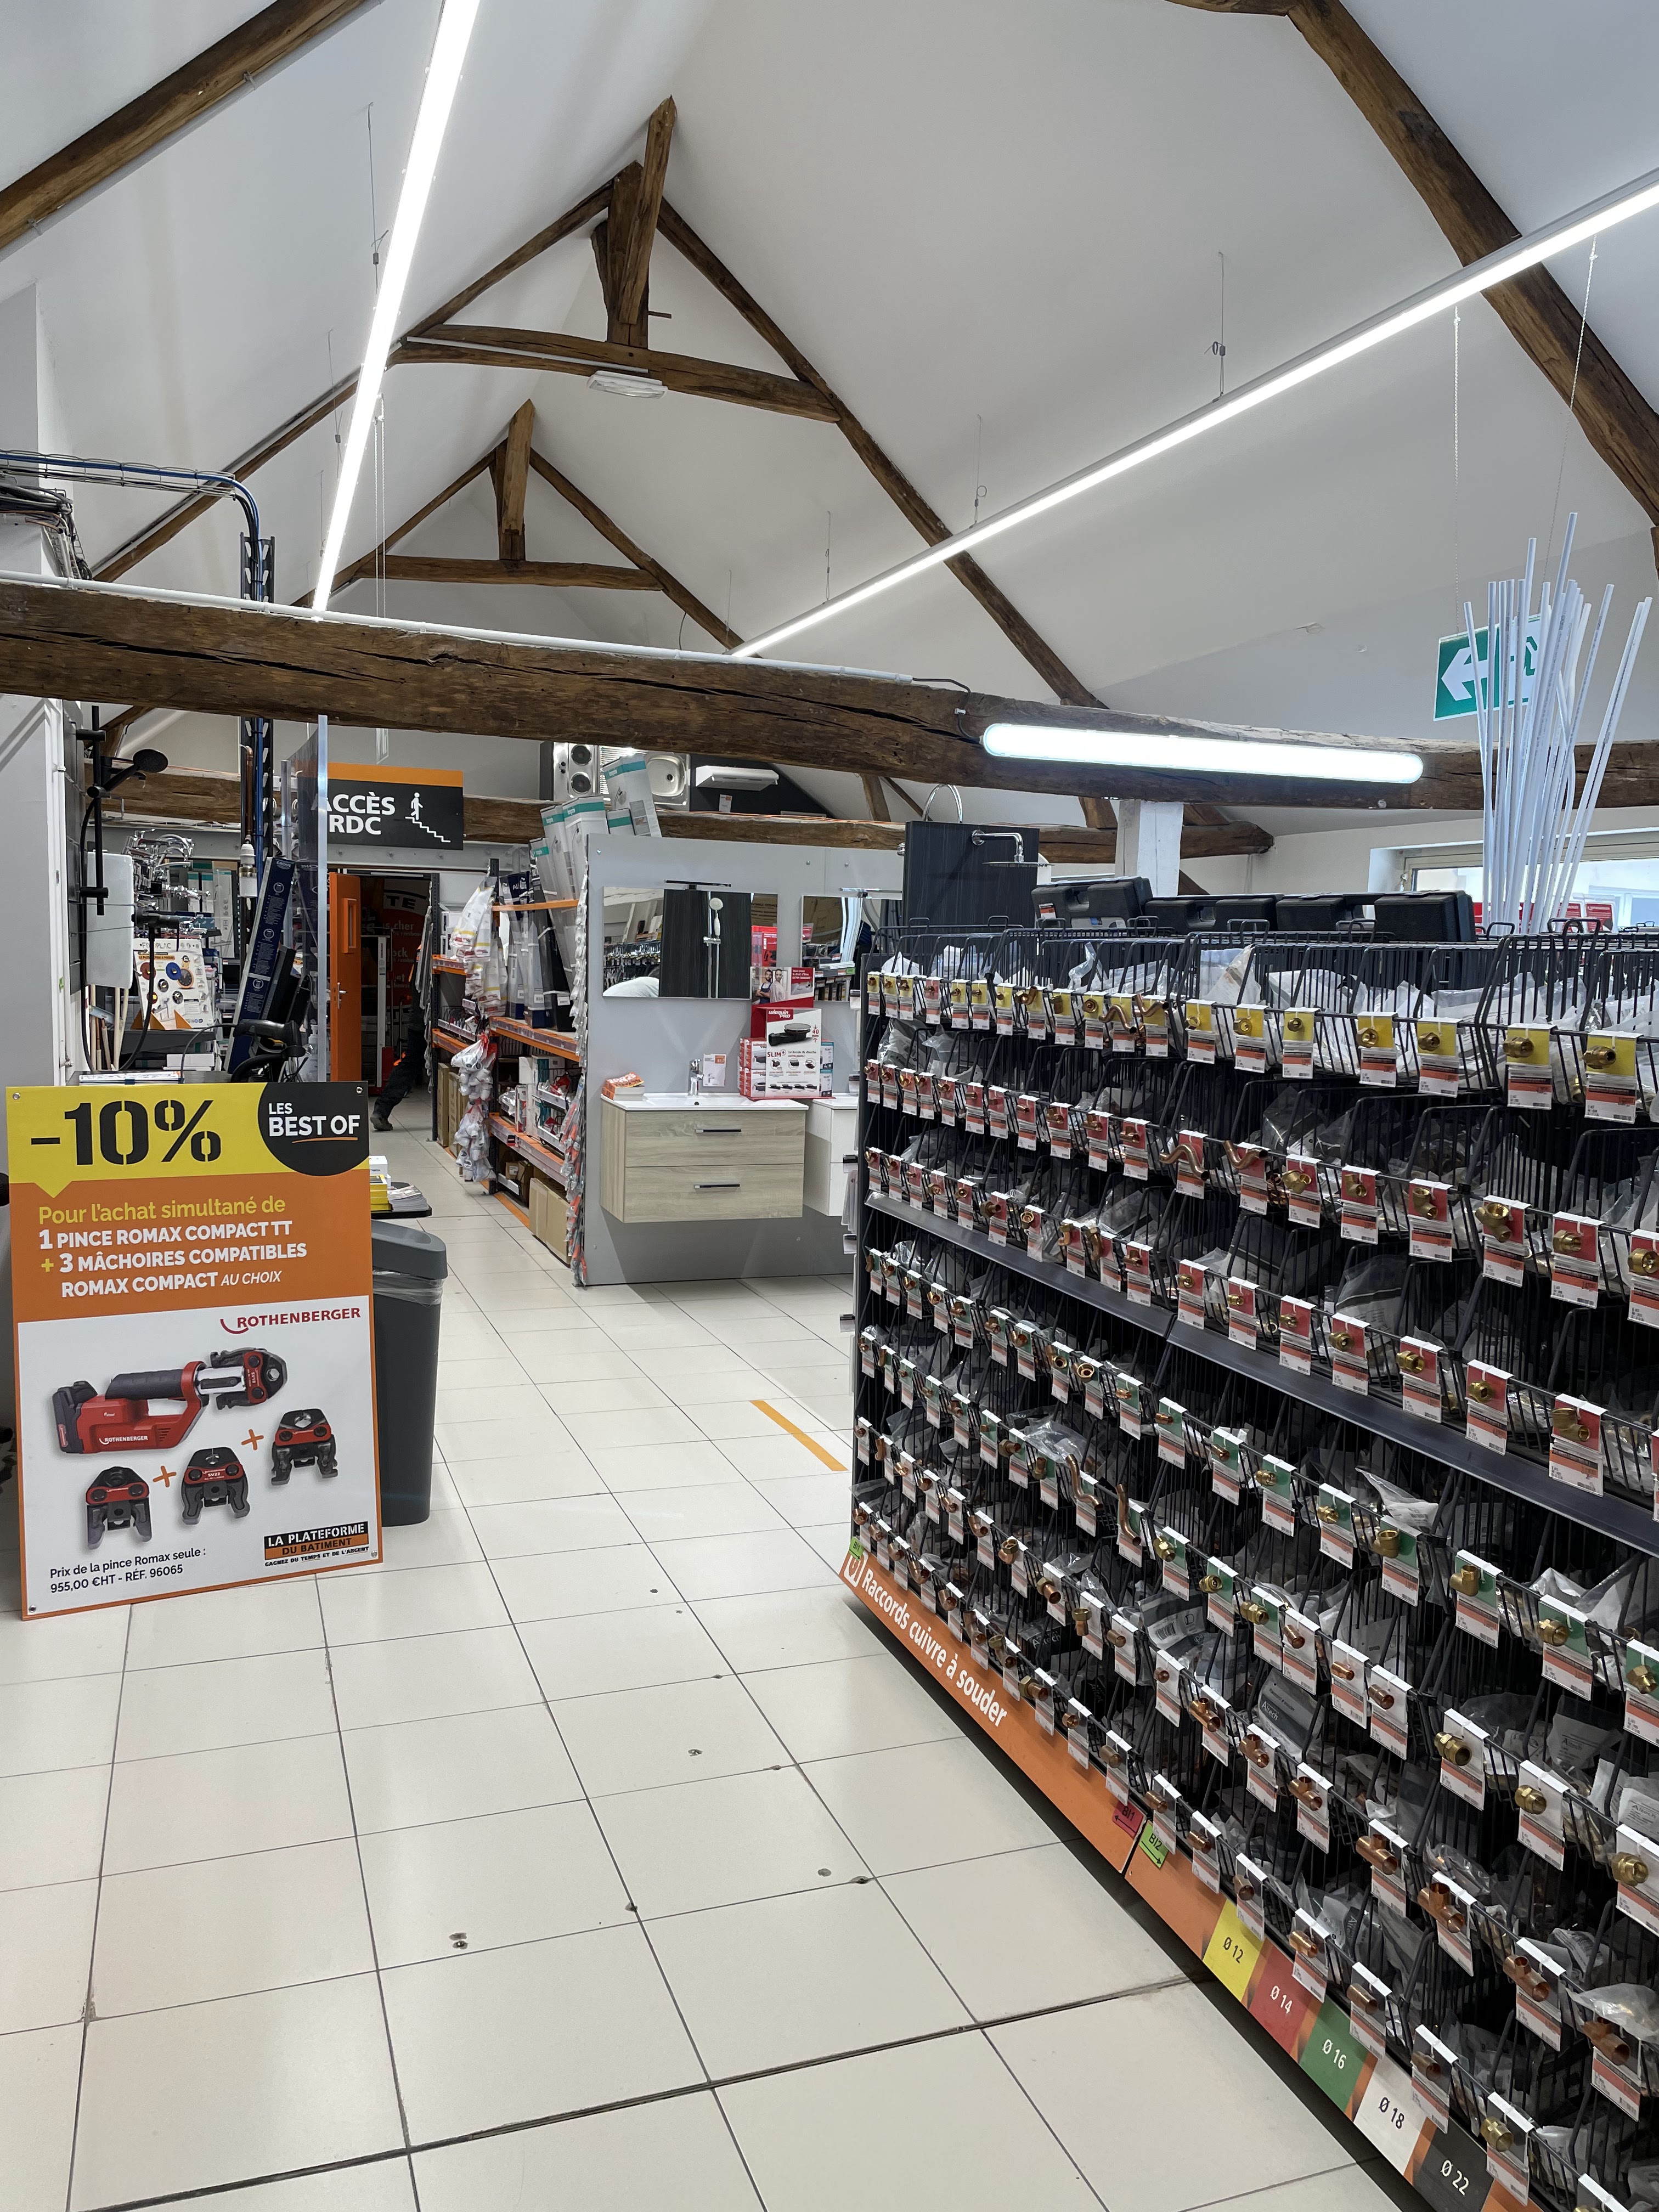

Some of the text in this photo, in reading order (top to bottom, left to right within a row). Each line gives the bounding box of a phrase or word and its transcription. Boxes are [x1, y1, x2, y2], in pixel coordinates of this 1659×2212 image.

[329, 814, 381, 835] RDC
[269, 1103, 292, 1115] LES
[269, 1115, 360, 1137] BEST OF
[39, 1205, 87, 1225] Pour
[162, 1196, 257, 1218] simultané
[262, 1195, 285, 1213] de
[40, 1220, 292, 1250] 1 PINCE ROMAX COMPACT TT
[59, 1253, 74, 1273] 3
[78, 1250, 185, 1272] MÂCHOIRES
[189, 1243, 307, 1265] COMPATIBLES
[61, 1271, 282, 1299] ROMAX COMPACT AU CHOIX
[237, 1307, 361, 1329] ROTHENBERGER
[268, 1523, 365, 1547] LA PLATEFORME
[282, 1538, 352, 1556] DU BATIMENT
[301, 1553, 321, 1562] TEMPS
[50, 1568, 71, 1579] Prix
[73, 1565, 87, 1576] de
[90, 1562, 100, 1573] la
[103, 1559, 132, 1572] pince
[134, 1554, 171, 1566] Romax
[173, 1548, 201, 1560] seule
[50, 1578, 89, 1593] 955,00
[92, 1574, 116, 1587] €HT
[125, 1568, 148, 1582] RÉF.
[150, 1564, 184, 1578] 96065
[862, 1567, 1008, 1727] Raccords cuivre à souder
[1232, 1945, 1245, 1964] 12
[1280, 1995, 1292, 2014] 14
[1334, 2050, 1347, 2069] 16
[1391, 2108, 1405, 2130] 18
[1452, 2170, 1470, 2197] 22
